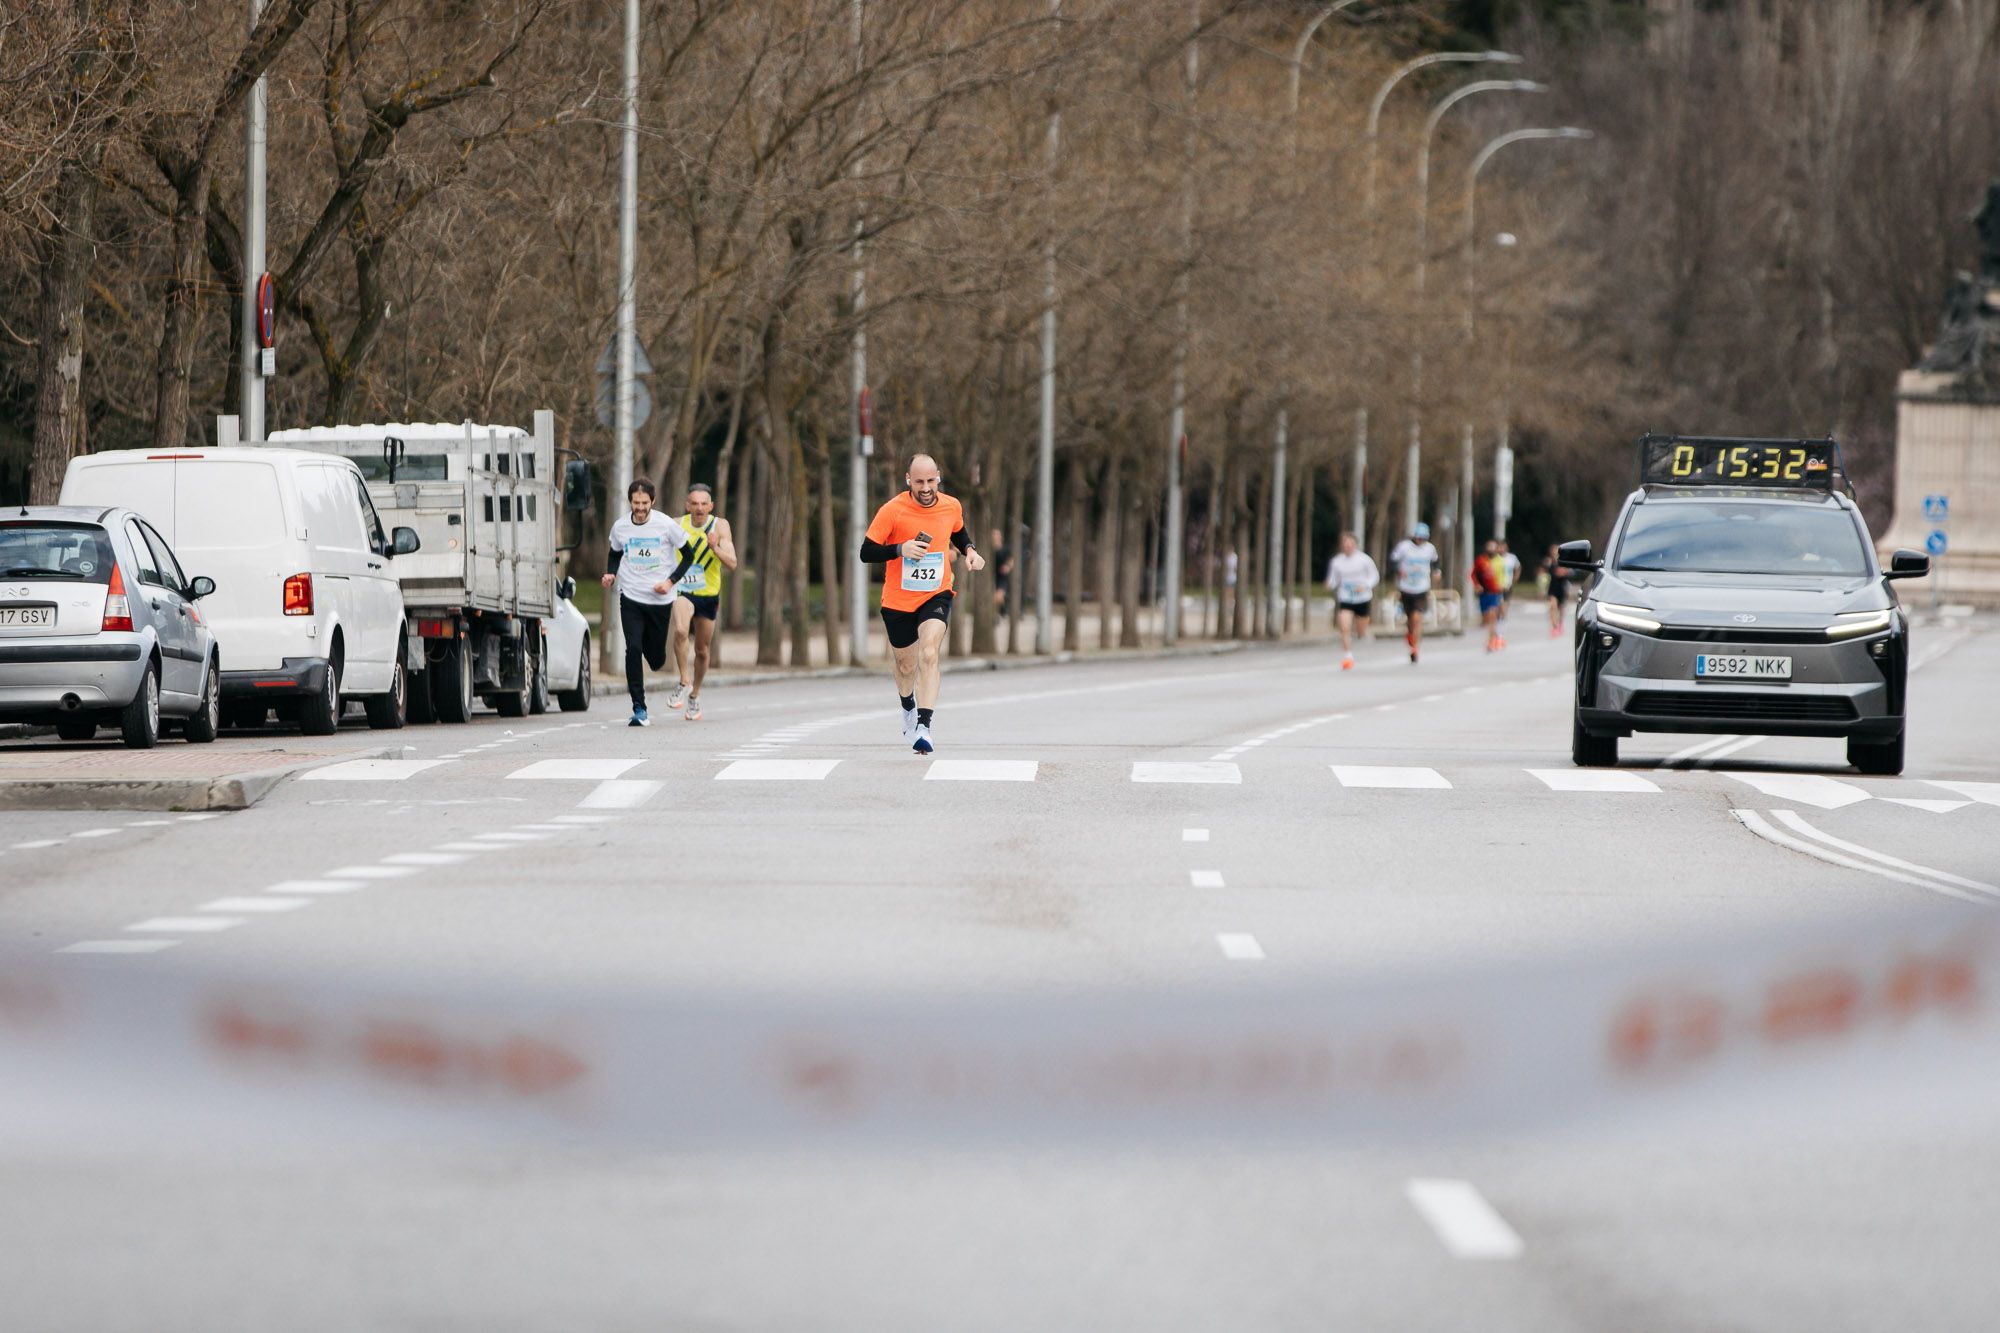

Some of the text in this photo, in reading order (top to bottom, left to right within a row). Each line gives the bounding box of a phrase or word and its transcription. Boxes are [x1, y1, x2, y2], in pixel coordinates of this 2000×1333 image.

[638, 548, 651, 557] 46
[911, 568, 936, 580] 432
[21, 610, 49, 623] GSV
[1708, 658, 1786, 674] 9592 NKK
